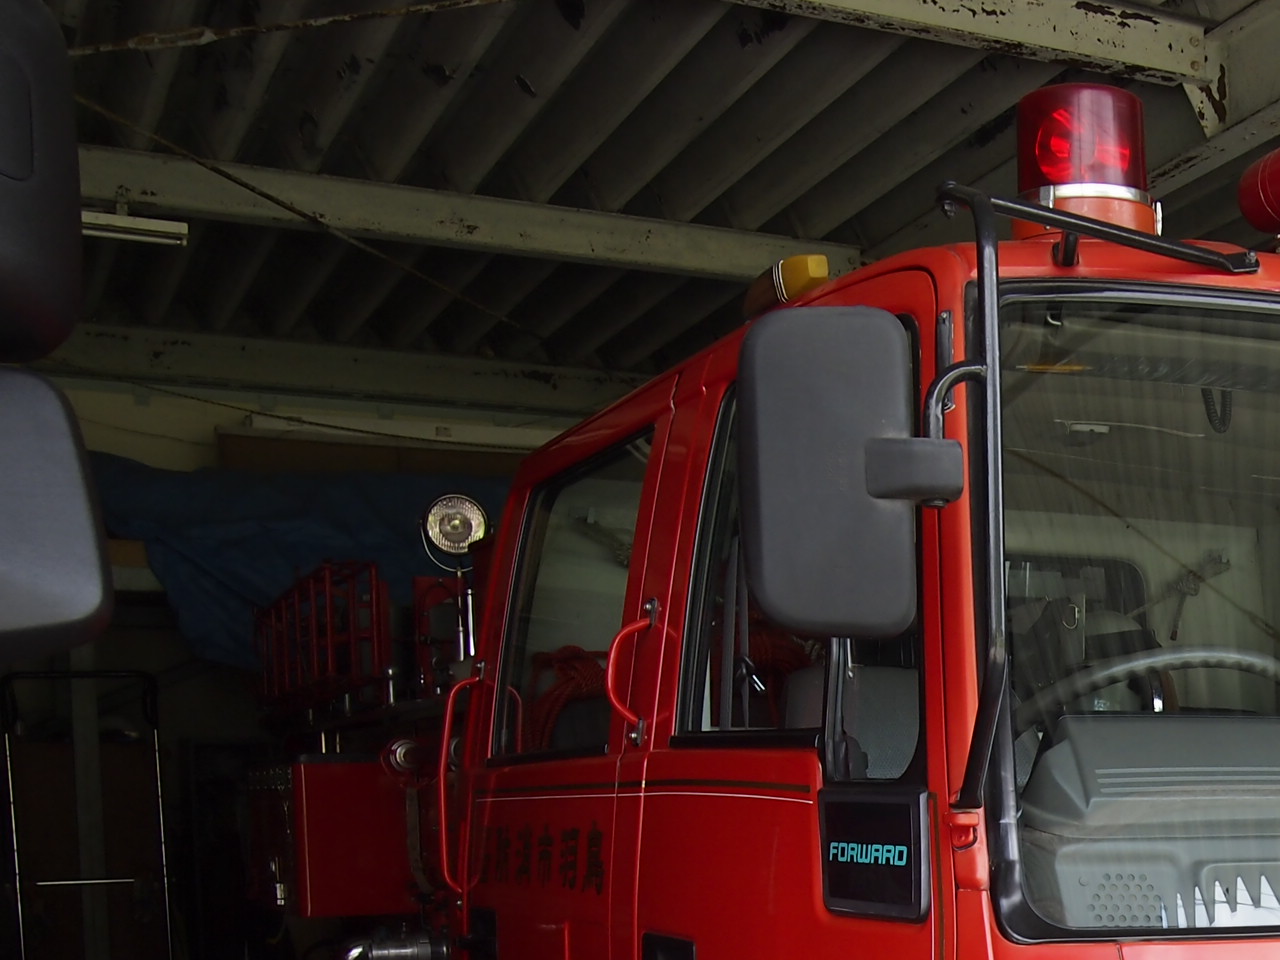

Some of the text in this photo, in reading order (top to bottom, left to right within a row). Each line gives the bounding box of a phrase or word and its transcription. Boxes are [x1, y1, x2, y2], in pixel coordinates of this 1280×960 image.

[478, 820, 606, 896] 鳥羽市消防
[829, 842, 908, 866] FORWARD
